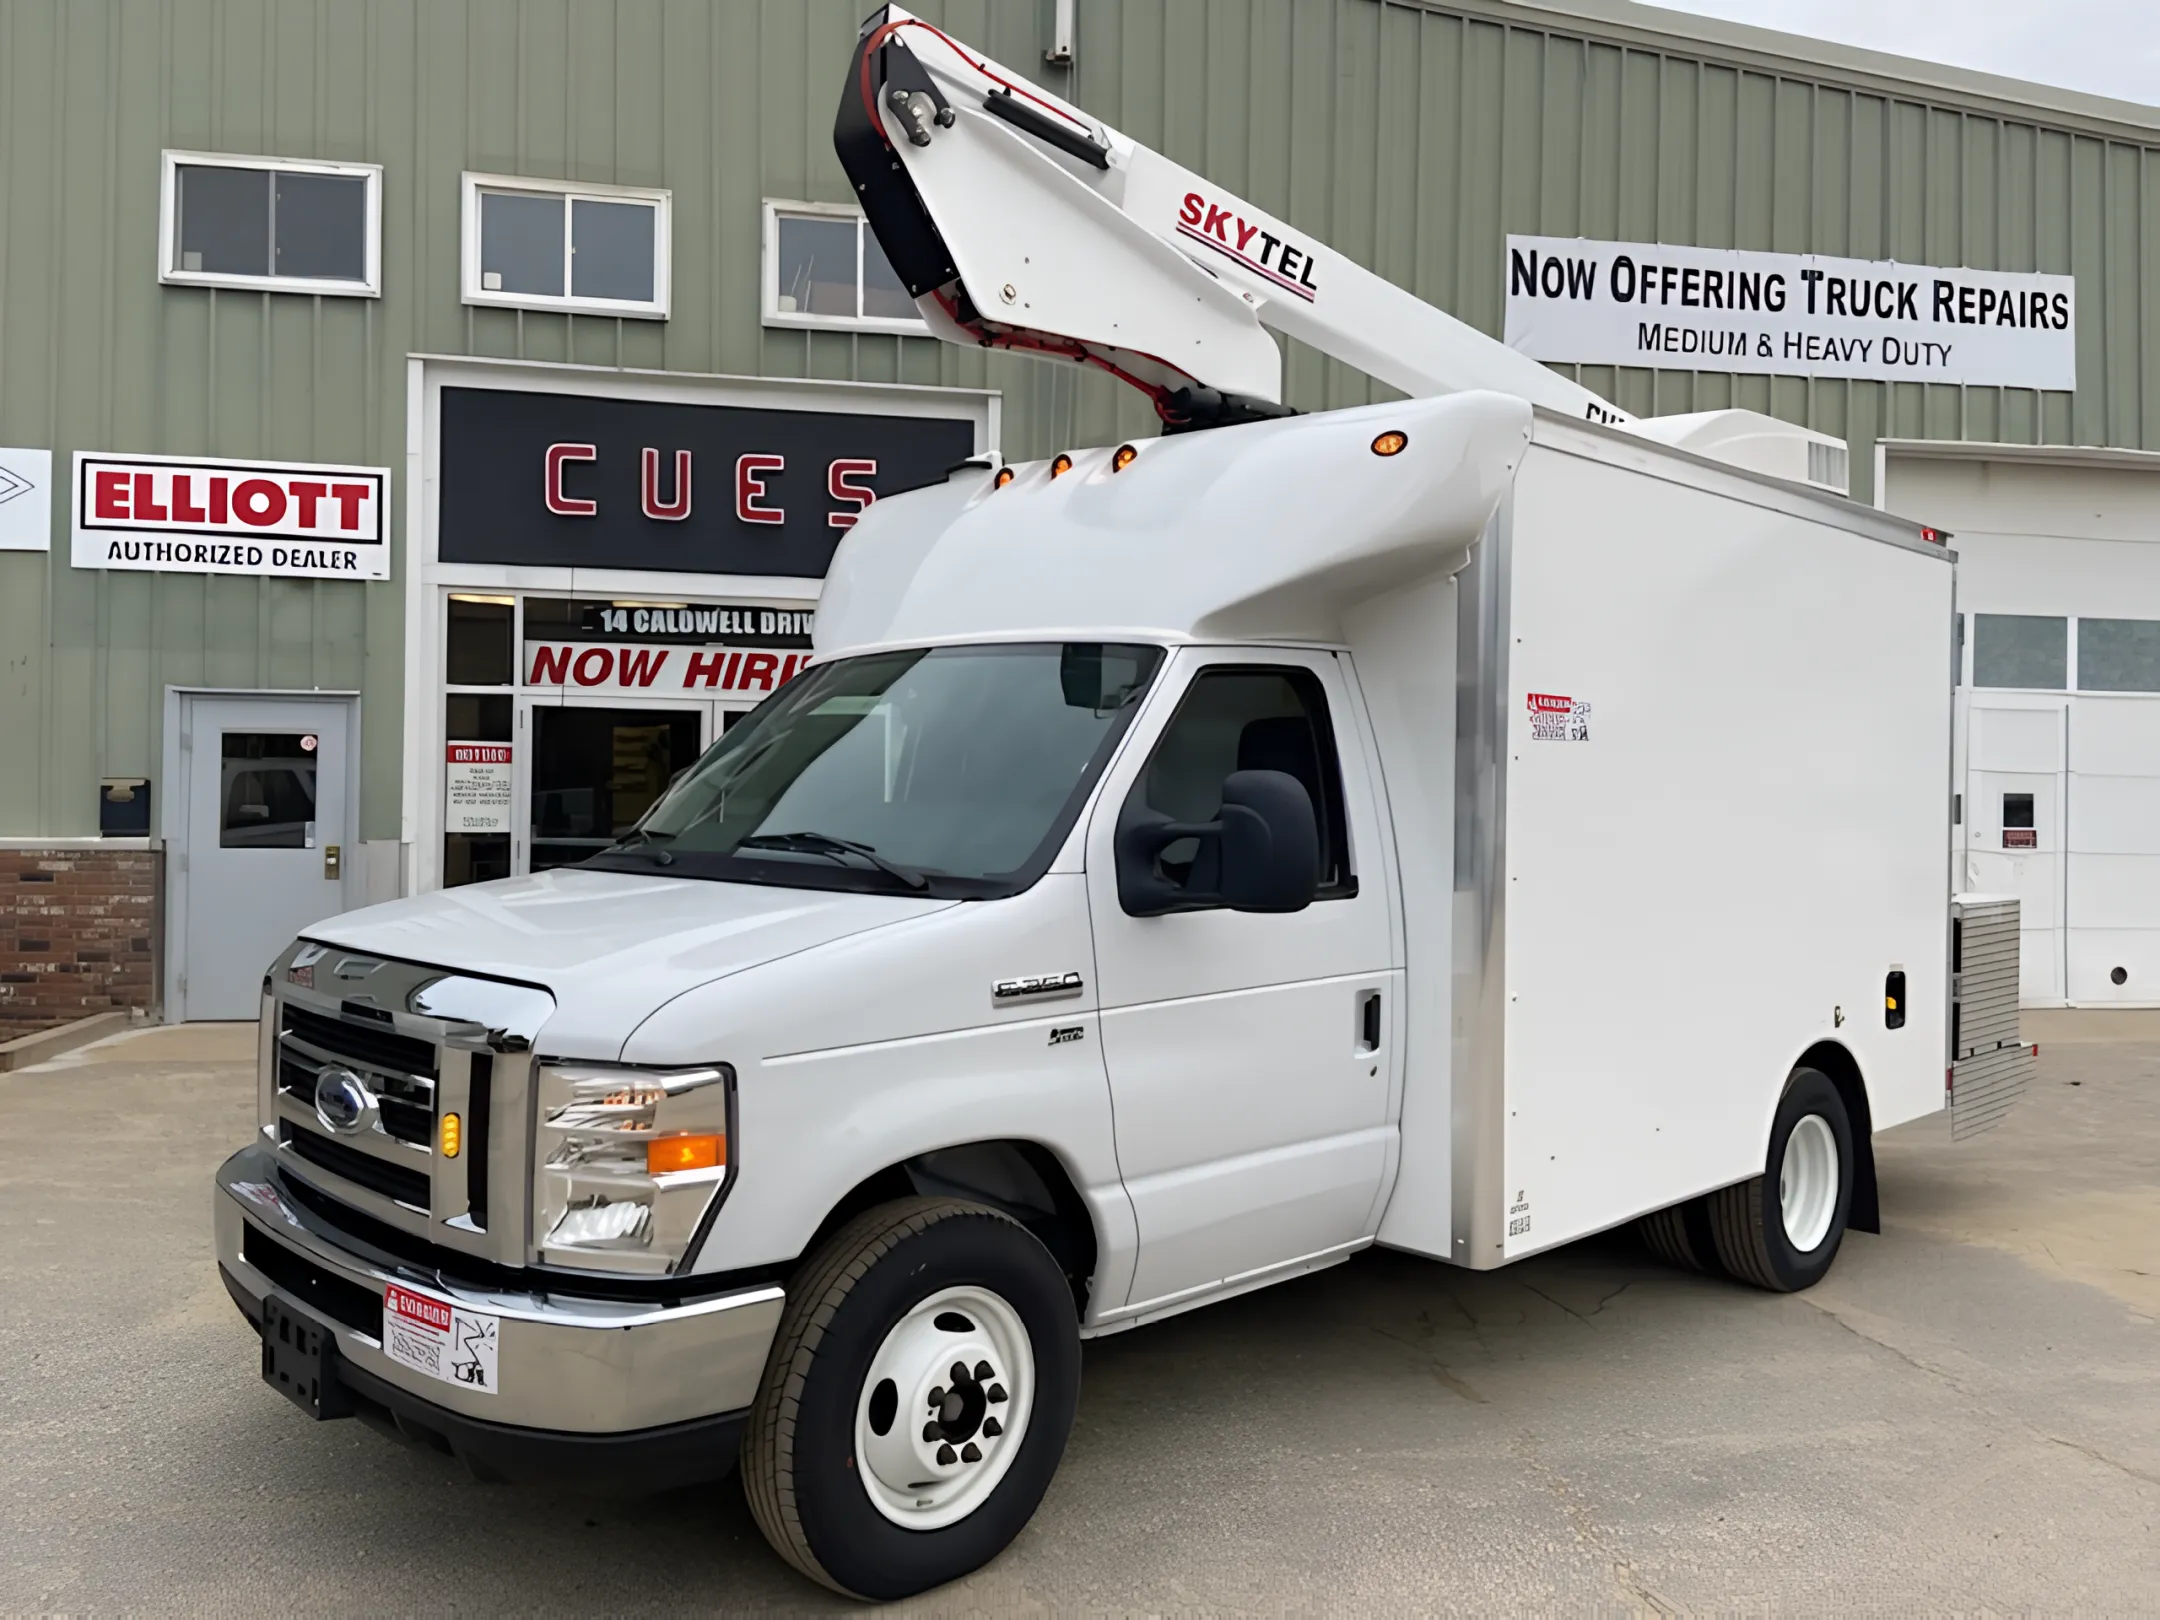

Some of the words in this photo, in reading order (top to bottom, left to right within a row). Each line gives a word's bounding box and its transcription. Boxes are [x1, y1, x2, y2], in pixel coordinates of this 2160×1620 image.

[1179, 192, 1318, 291] SKYTEL
[1756, 333, 1773, 357] &
[95, 470, 370, 531] ELLIOTT
[544, 443, 877, 528] CUES
[108, 541, 263, 566] AUTHORIZED
[272, 548, 358, 570] DEALER
[600, 609, 628, 633] 14
[633, 609, 755, 635] CALDWELL
[530, 646, 669, 688] NOW
[682, 652, 814, 692] HIRI
